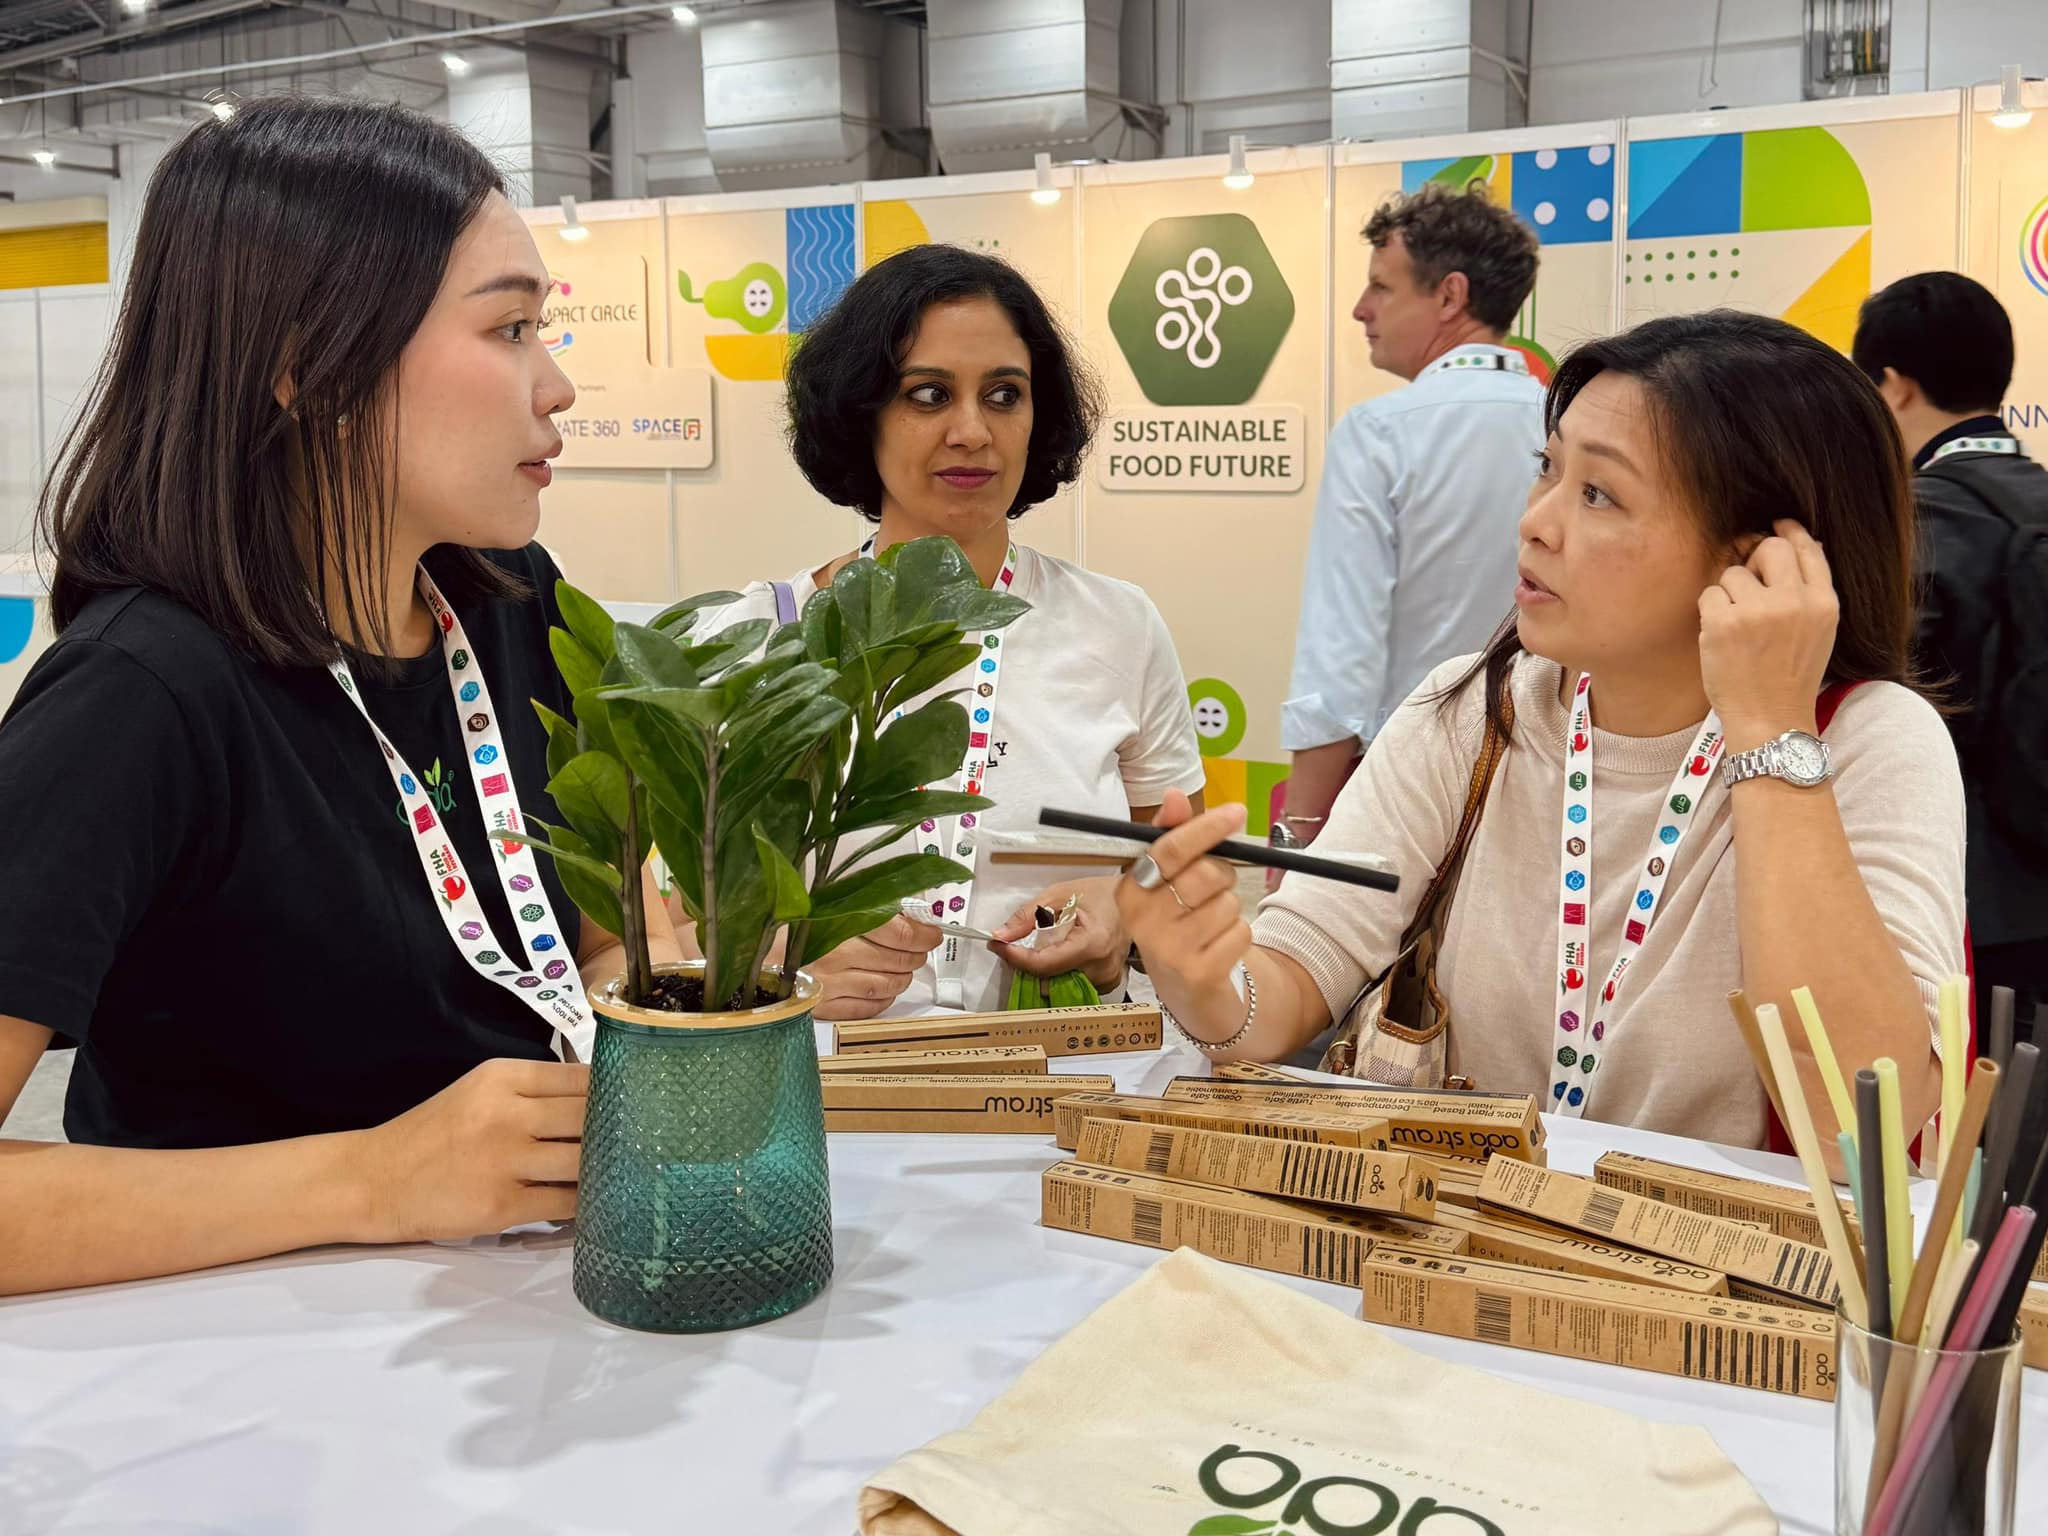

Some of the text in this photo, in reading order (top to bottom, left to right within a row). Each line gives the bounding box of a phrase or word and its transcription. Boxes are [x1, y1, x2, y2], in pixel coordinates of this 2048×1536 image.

[540, 304, 638, 324] MPACT CIRCLE
[558, 419, 620, 437] ATE 360
[632, 419, 682, 432] SPACE
[1113, 419, 1287, 442] SUSTAINABLE
[1110, 455, 1291, 477] FOOD FUTURE
[1574, 709, 1584, 730] FHA
[1698, 732, 1717, 754] FHA
[968, 760, 978, 778] FHA
[430, 849, 447, 876] FHA
[1565, 942, 1576, 965] FHA
[924, 1049, 989, 1058] straw
[984, 1096, 1054, 1119] straw
[1335, 1101, 1411, 1112] Decomposable
[1361, 1095, 1397, 1104] Friendly
[1417, 1099, 1440, 1107] 100%
[1432, 1106, 1523, 1119] 100% Plant Based
[1390, 1127, 1520, 1151] ada straw
[1528, 1184, 1541, 1208] BIOTECH
[1559, 1238, 1649, 1265] straw
[1653, 1258, 1711, 1280] ada
[1417, 1295, 1425, 1326] BIOTECH
[1815, 1352, 1829, 1386] ada
